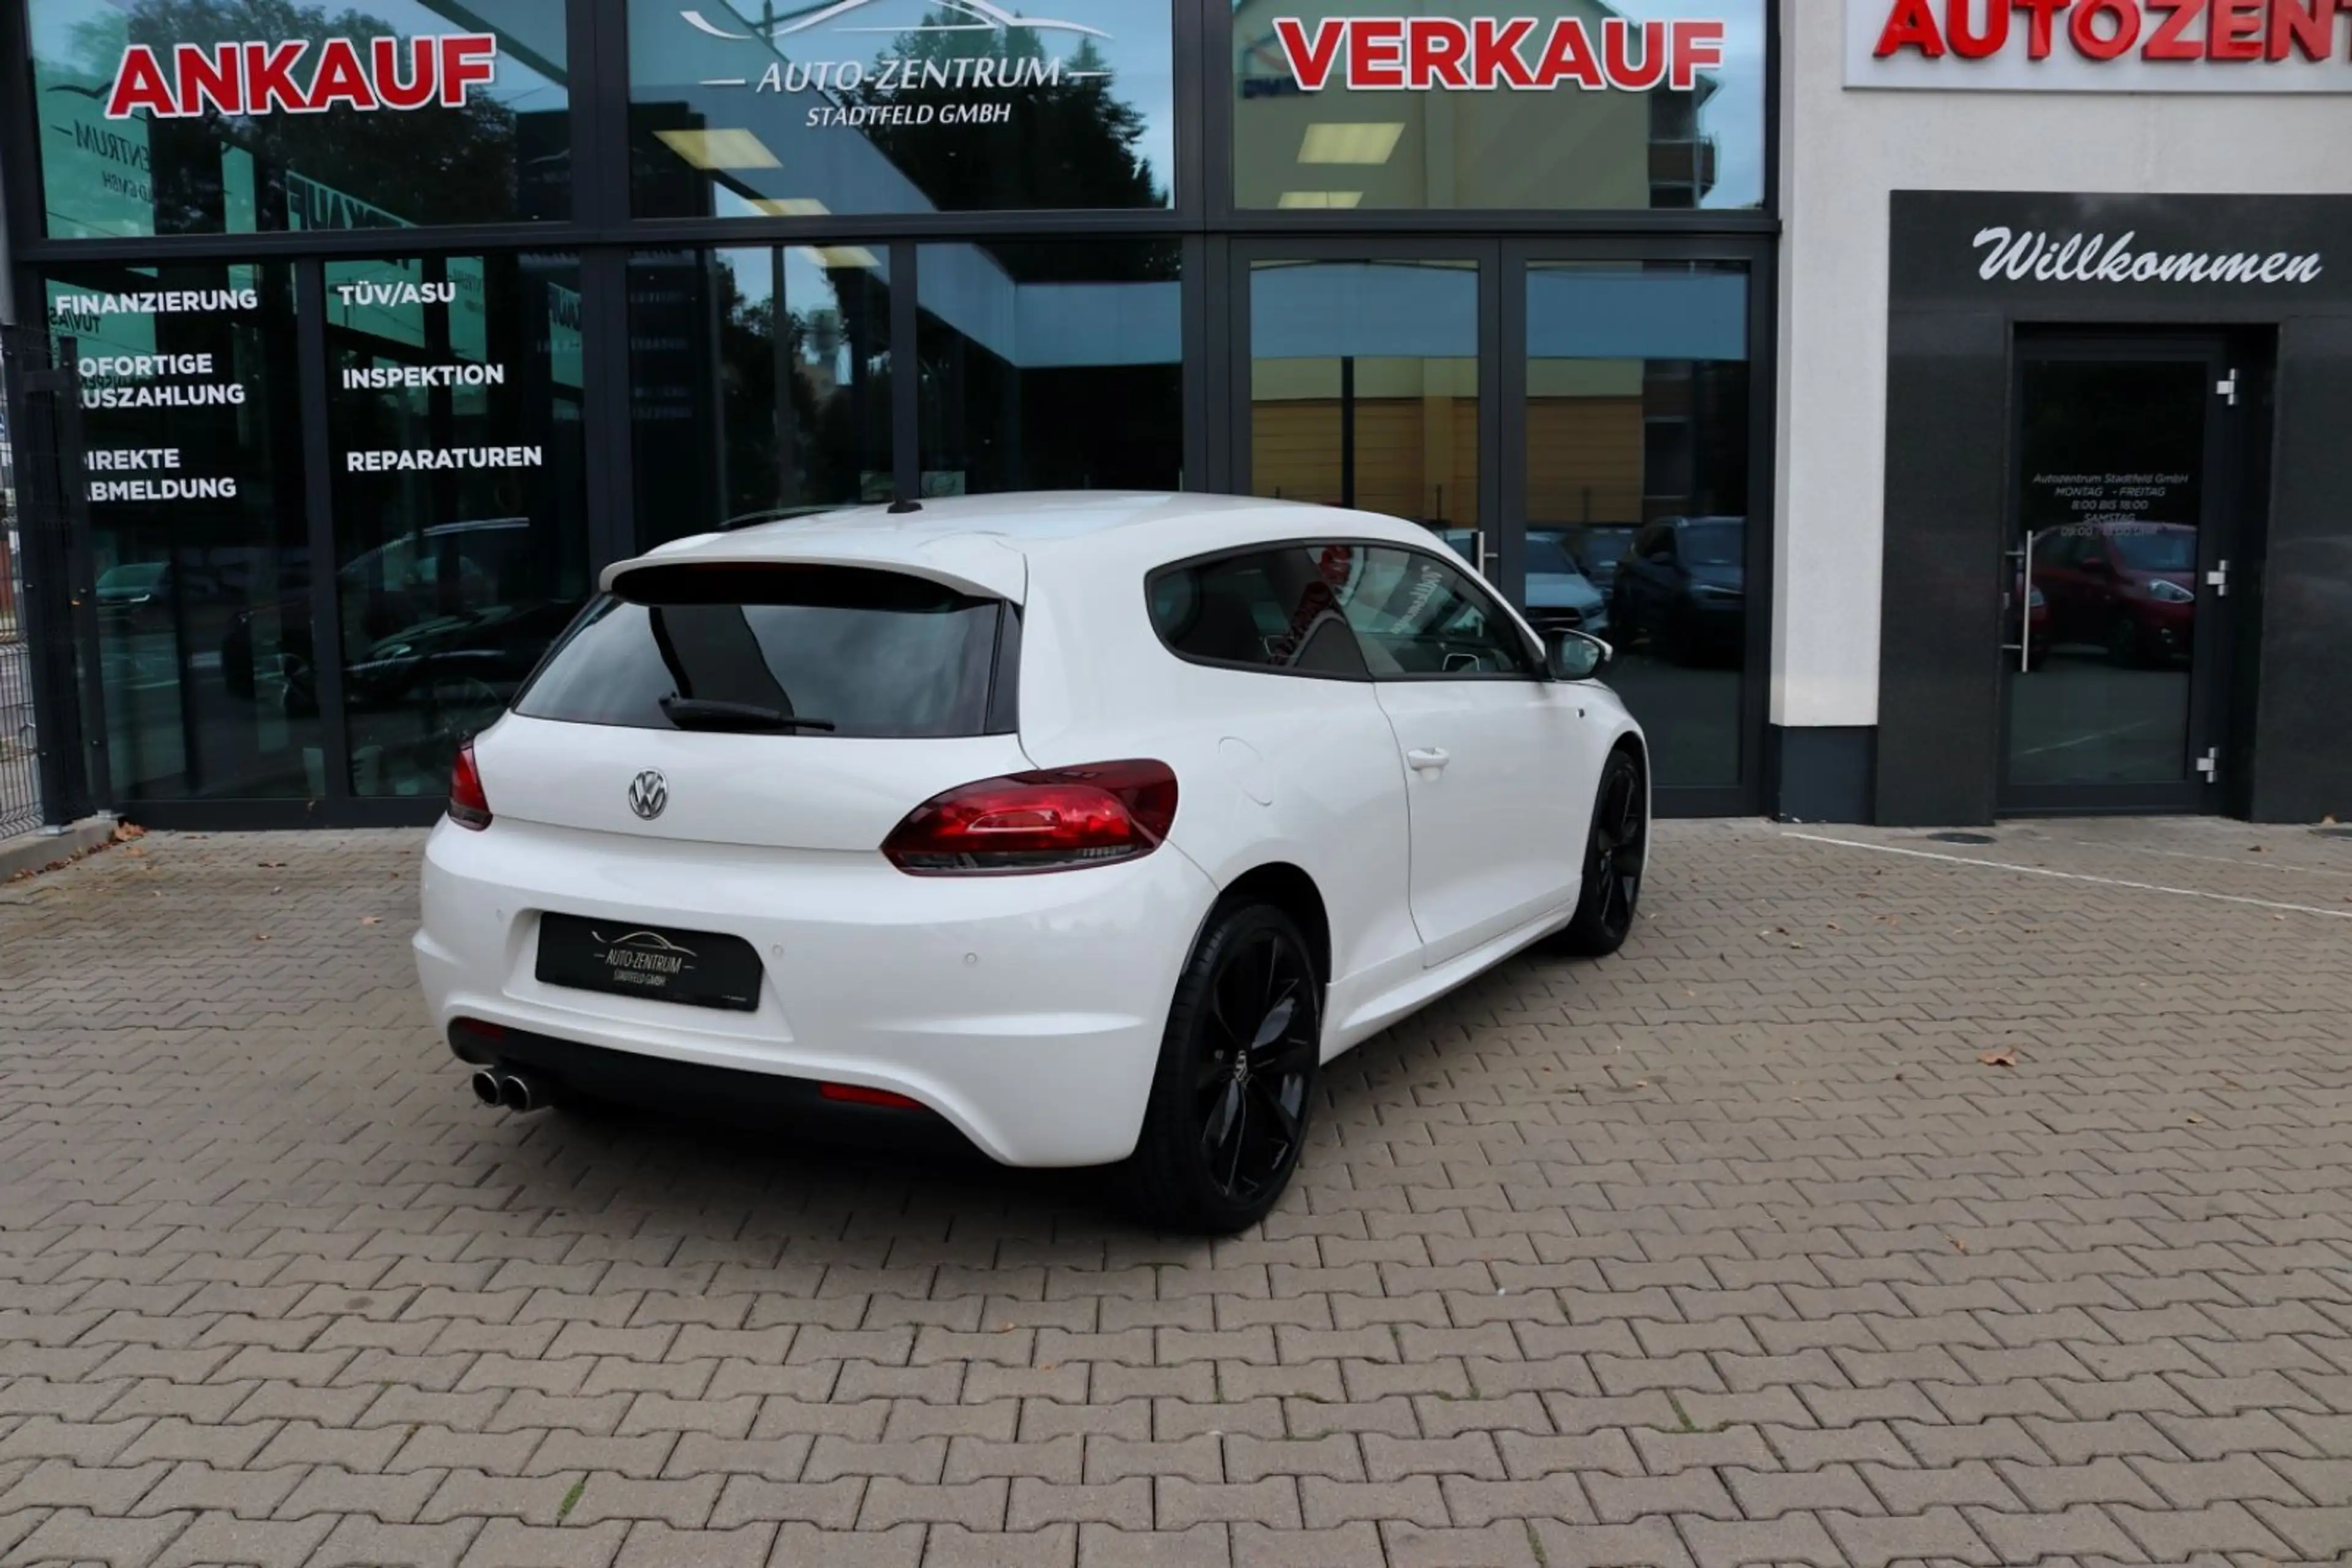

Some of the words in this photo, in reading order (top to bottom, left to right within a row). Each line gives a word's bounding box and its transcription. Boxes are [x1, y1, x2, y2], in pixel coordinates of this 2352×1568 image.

[1273, 17, 1726, 92] VERKAUF
[105, 33, 497, 119] ANKAUF
[756, 57, 1061, 93] AUTO-ZENTRUM
[805, 105, 933, 127] STADTFELD
[939, 103, 1011, 124] GMBH
[1973, 226, 2324, 283] Willkommen
[56, 288, 258, 315] FINANZIERUNG
[337, 281, 456, 307] TÜV/ASU
[78, 353, 213, 378] OFORTIGE
[343, 364, 504, 389] INSPEKTION
[80, 383, 245, 409] USZAHLUNG
[84, 448, 180, 470] IREKTE
[347, 446, 542, 472] REPARATUREN
[88, 477, 236, 501] BMELDUNG
[2054, 487, 2103, 497] MONTAG
[2119, 487, 2166, 497] FREITAG
[605, 949, 683, 974] AUTO-ZENTRUM
